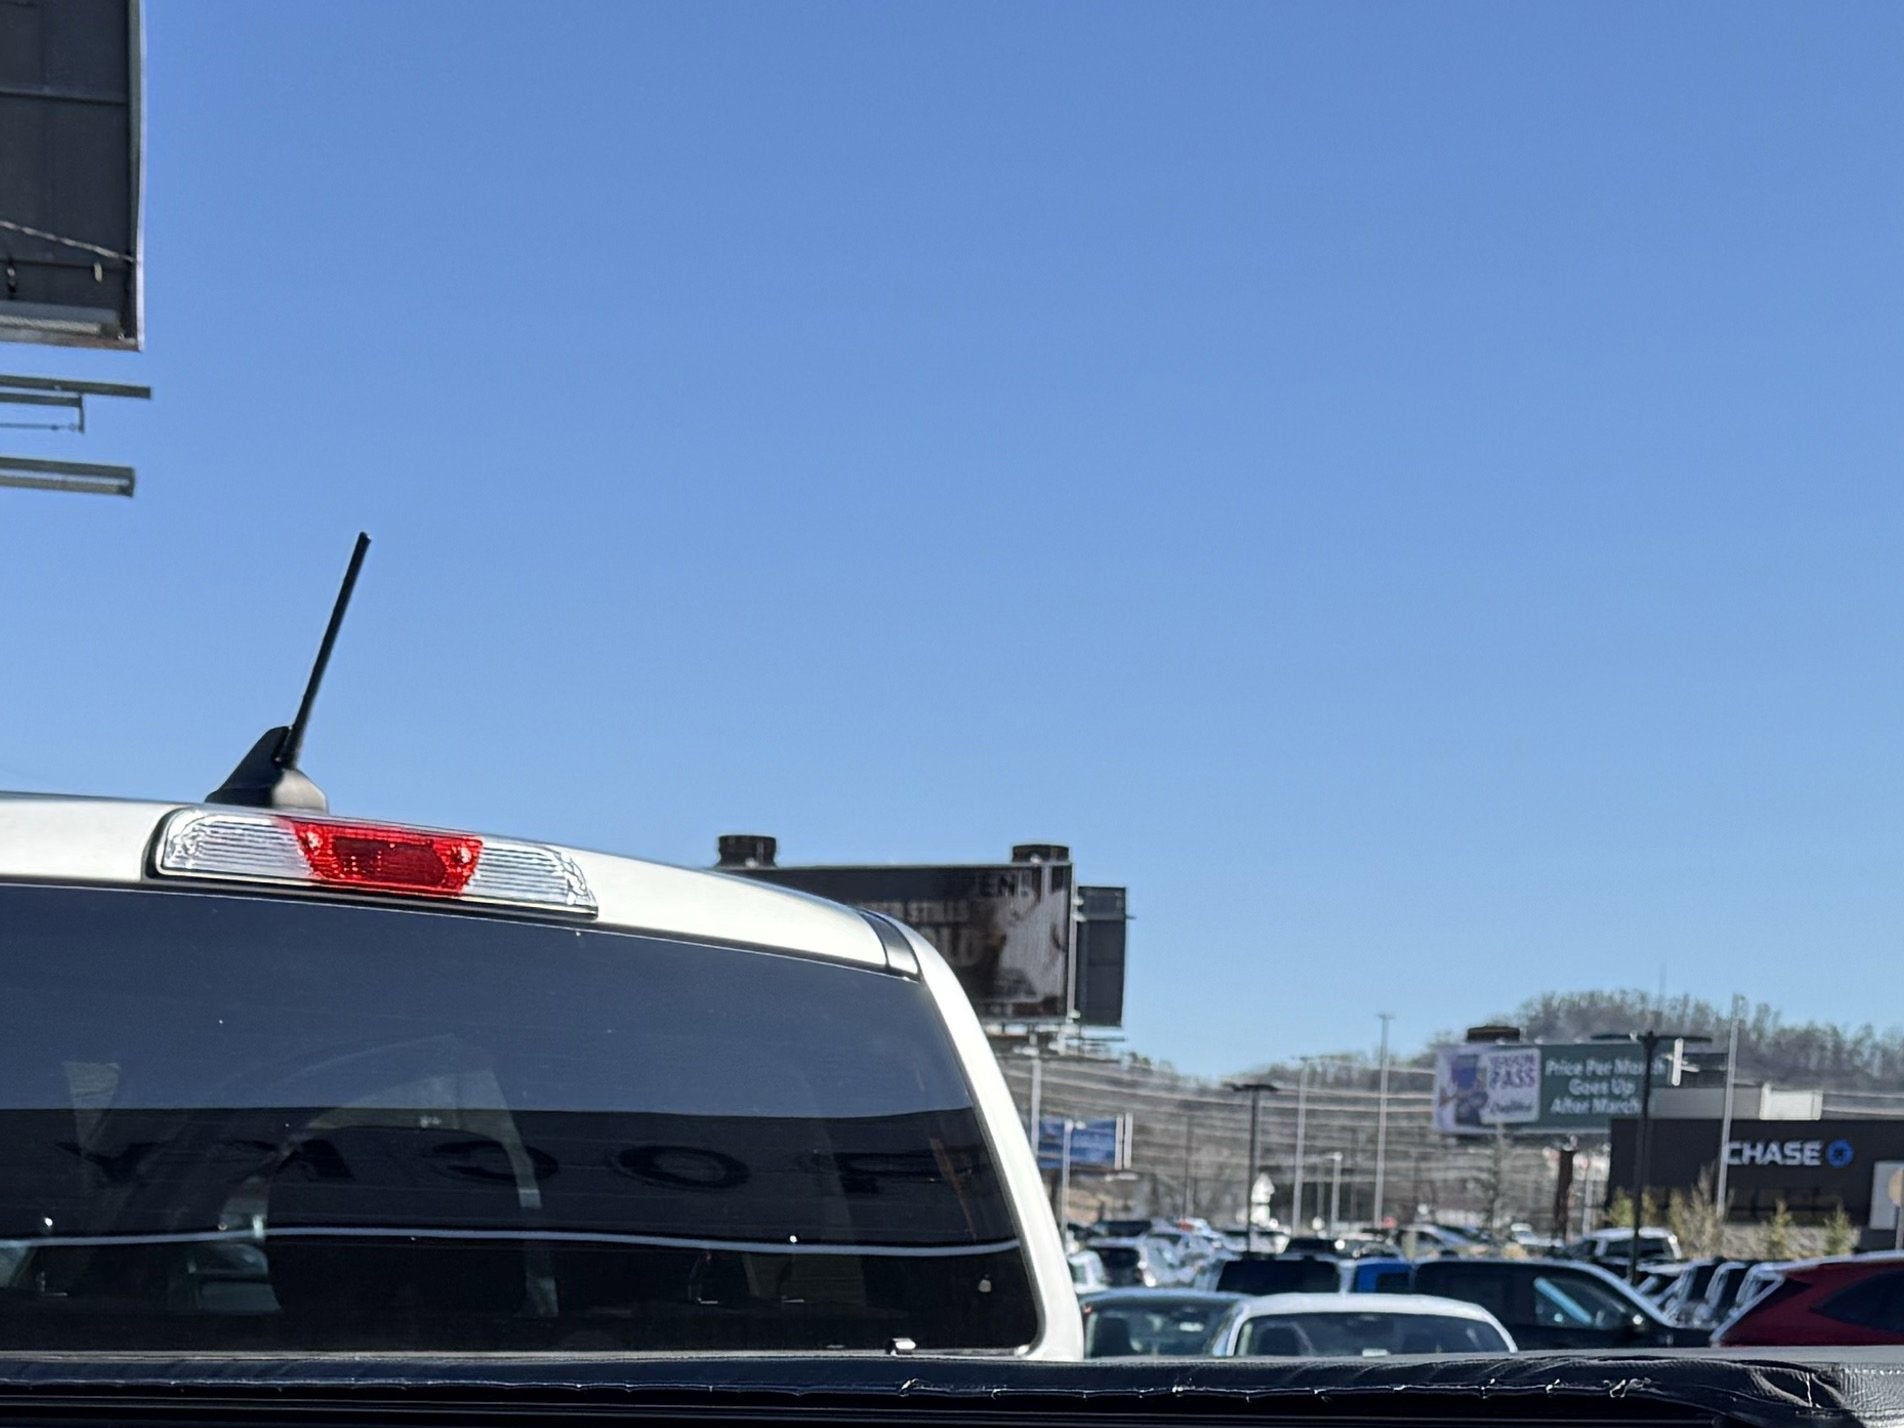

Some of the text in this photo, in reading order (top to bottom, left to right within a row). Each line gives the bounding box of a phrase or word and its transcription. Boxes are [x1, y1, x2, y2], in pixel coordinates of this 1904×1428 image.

[1545, 1057, 1584, 1076] Price
[1586, 1057, 1613, 1076] Per
[1568, 1078, 1636, 1098] Goes Up
[1550, 1098, 1589, 1114] After
[1592, 1098, 1643, 1115] March
[1726, 1140, 1823, 1166] CHASE
